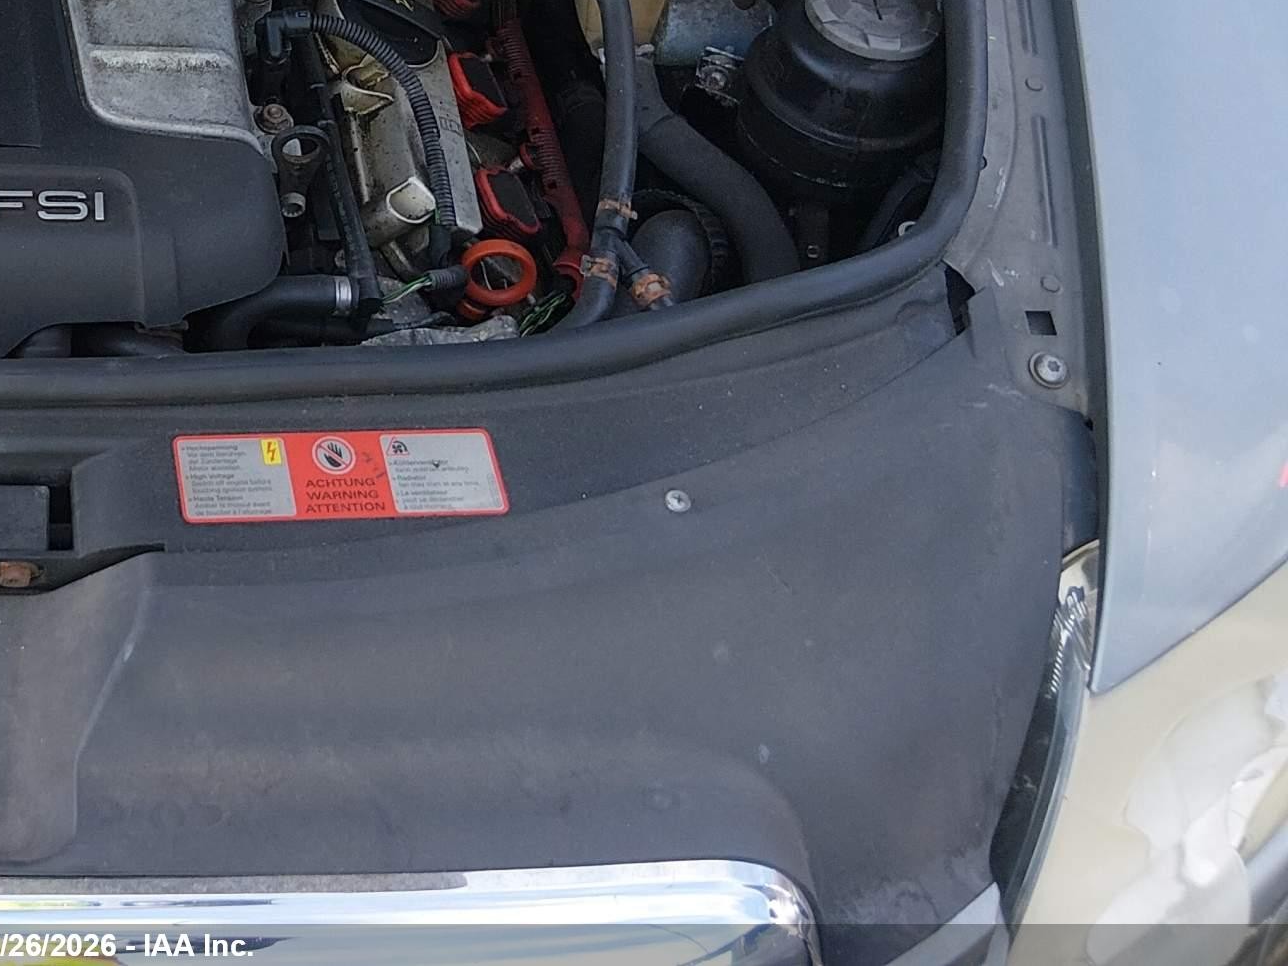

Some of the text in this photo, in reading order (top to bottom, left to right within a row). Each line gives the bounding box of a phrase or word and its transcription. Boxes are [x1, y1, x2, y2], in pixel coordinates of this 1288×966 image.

[305, 477, 376, 489] ACHTUNG
[306, 489, 379, 501] WARNING
[305, 501, 386, 513] ATTENTION
